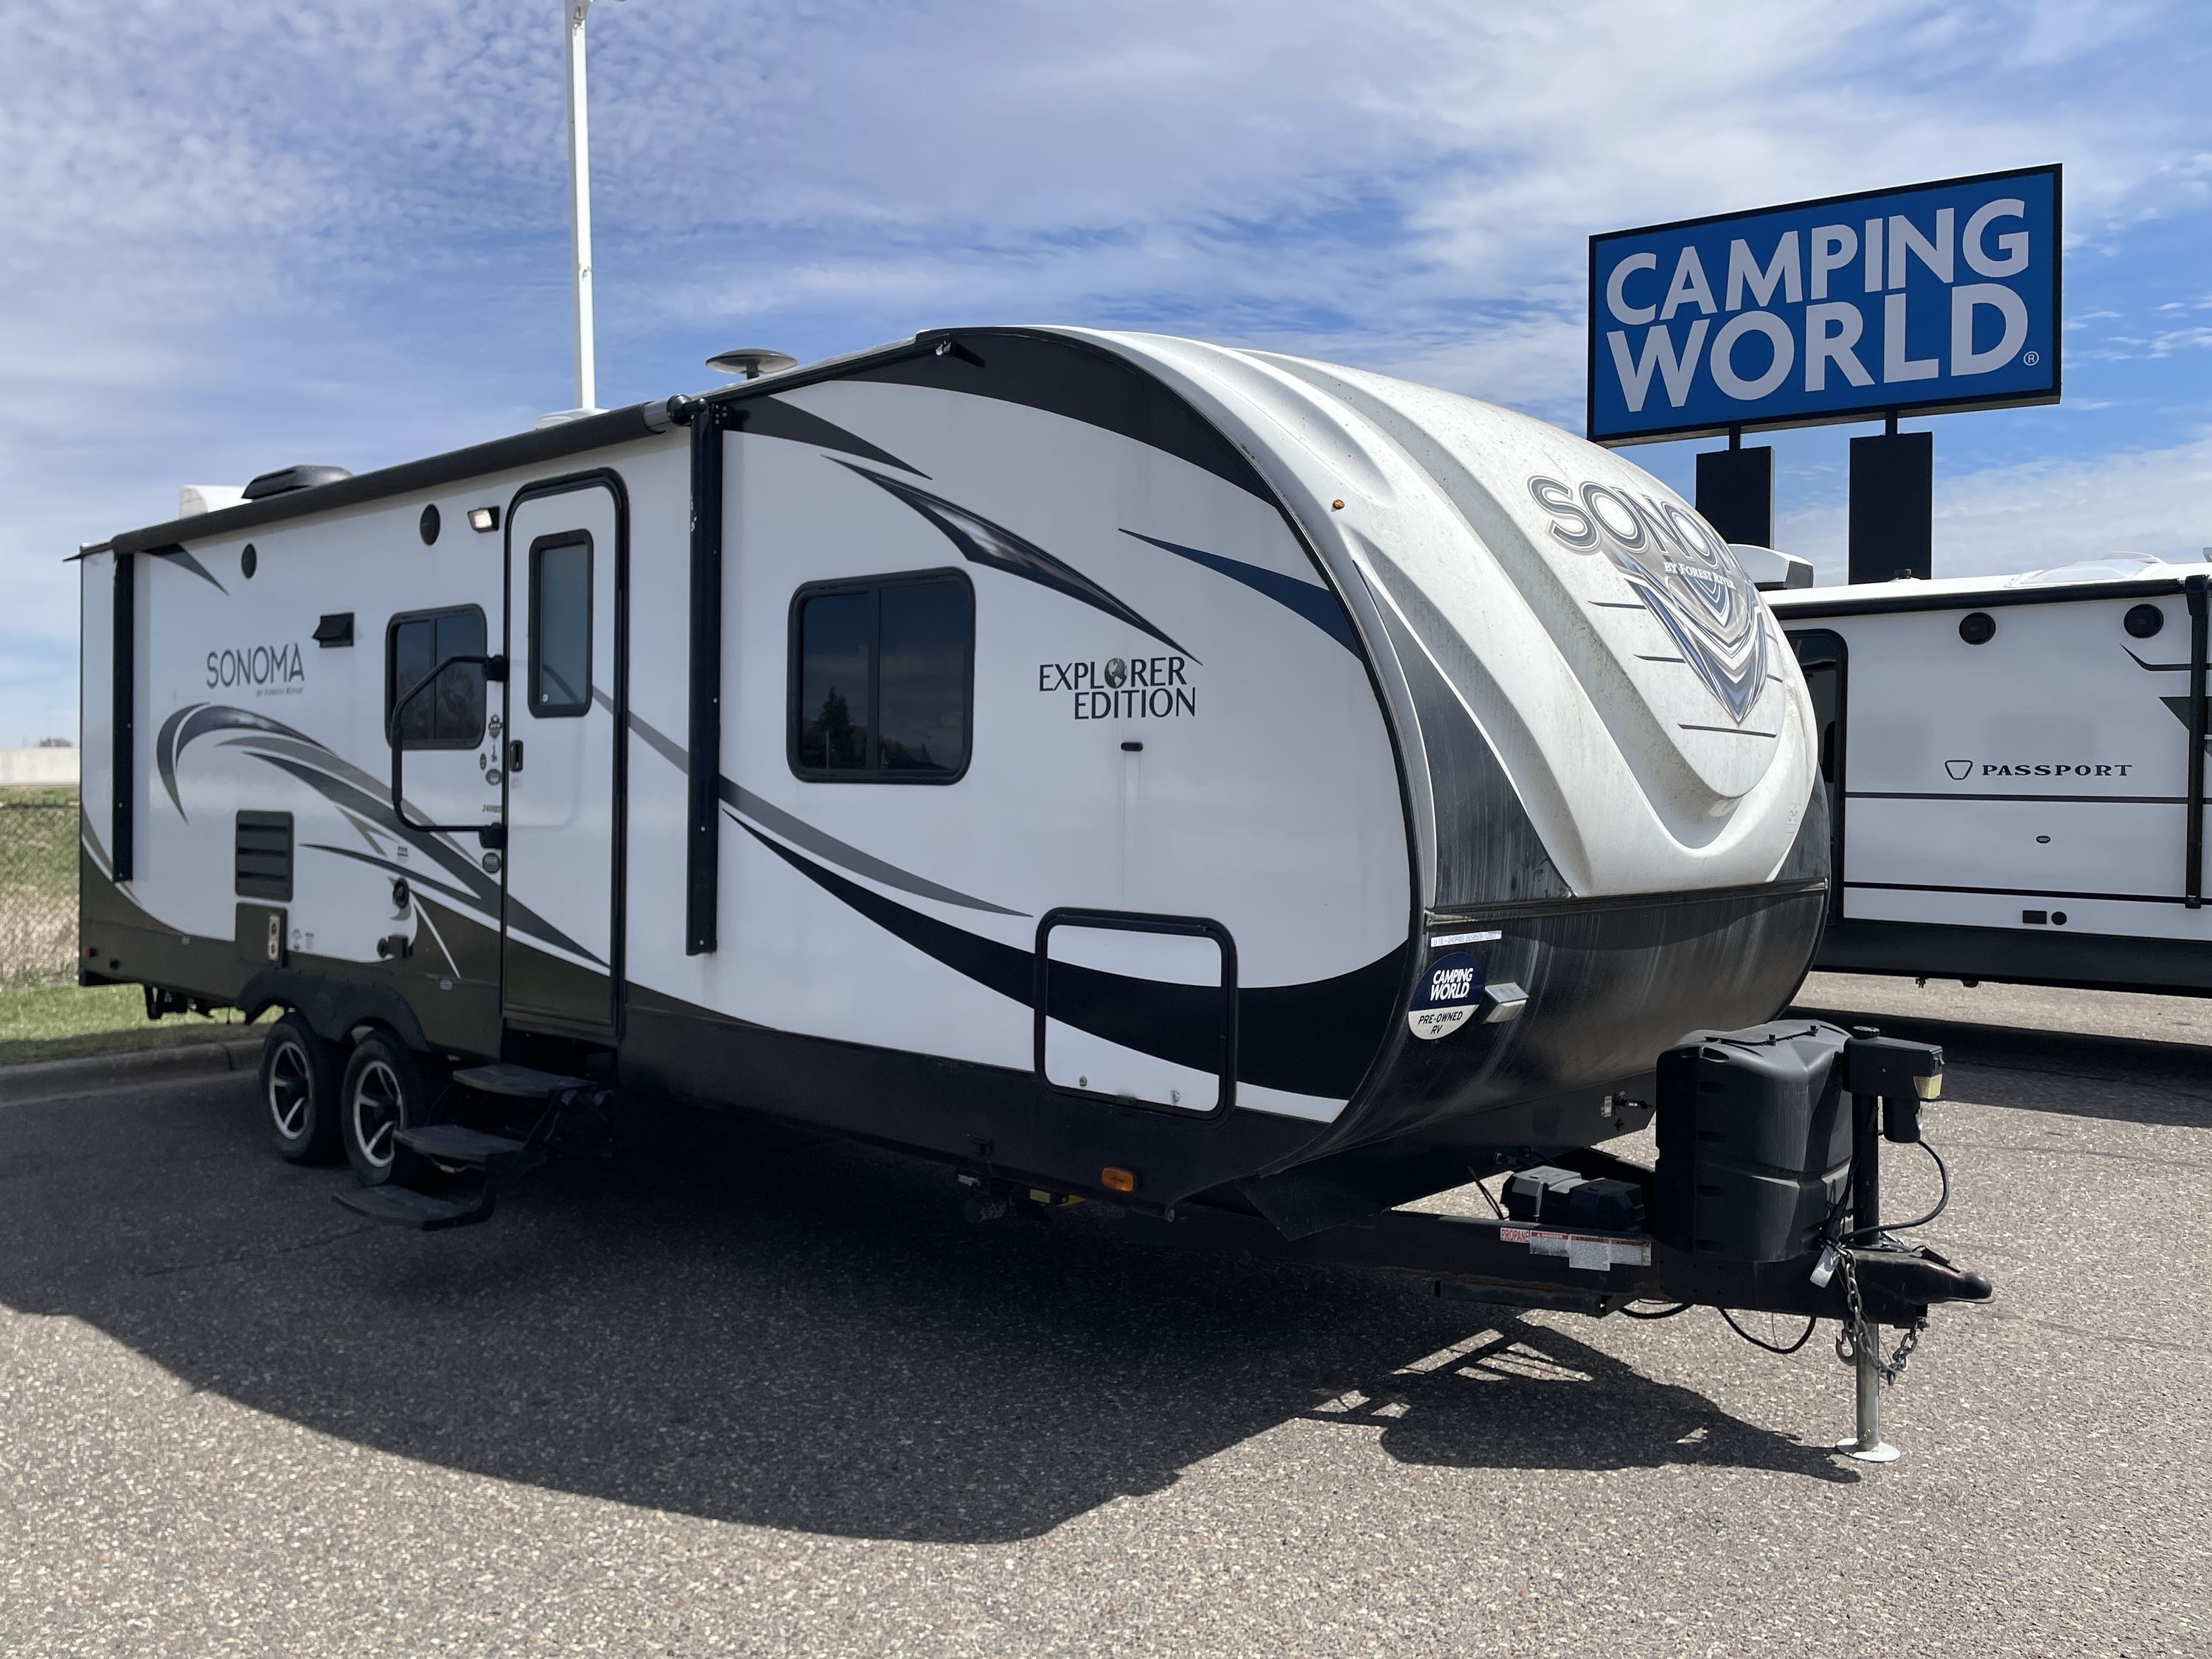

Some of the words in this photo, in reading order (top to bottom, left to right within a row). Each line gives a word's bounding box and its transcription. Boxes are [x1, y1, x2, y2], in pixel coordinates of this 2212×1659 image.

[1607, 198, 2029, 325] CAMPING
[1528, 476, 1737, 573] SONOM
[206, 642, 305, 689] SONOMA
[1040, 656, 1187, 692] EXPLORER
[1074, 687, 1196, 720] EDITION
[1982, 764, 2132, 776] PASSPORT
[1433, 967, 1474, 985] CAMPING
[1430, 981, 1470, 1001] WORLD
[1418, 1011, 1464, 1025] PRE-OWNED
[1430, 1025, 1443, 1034] RV
[1501, 1228, 1529, 1242] PROPANE
